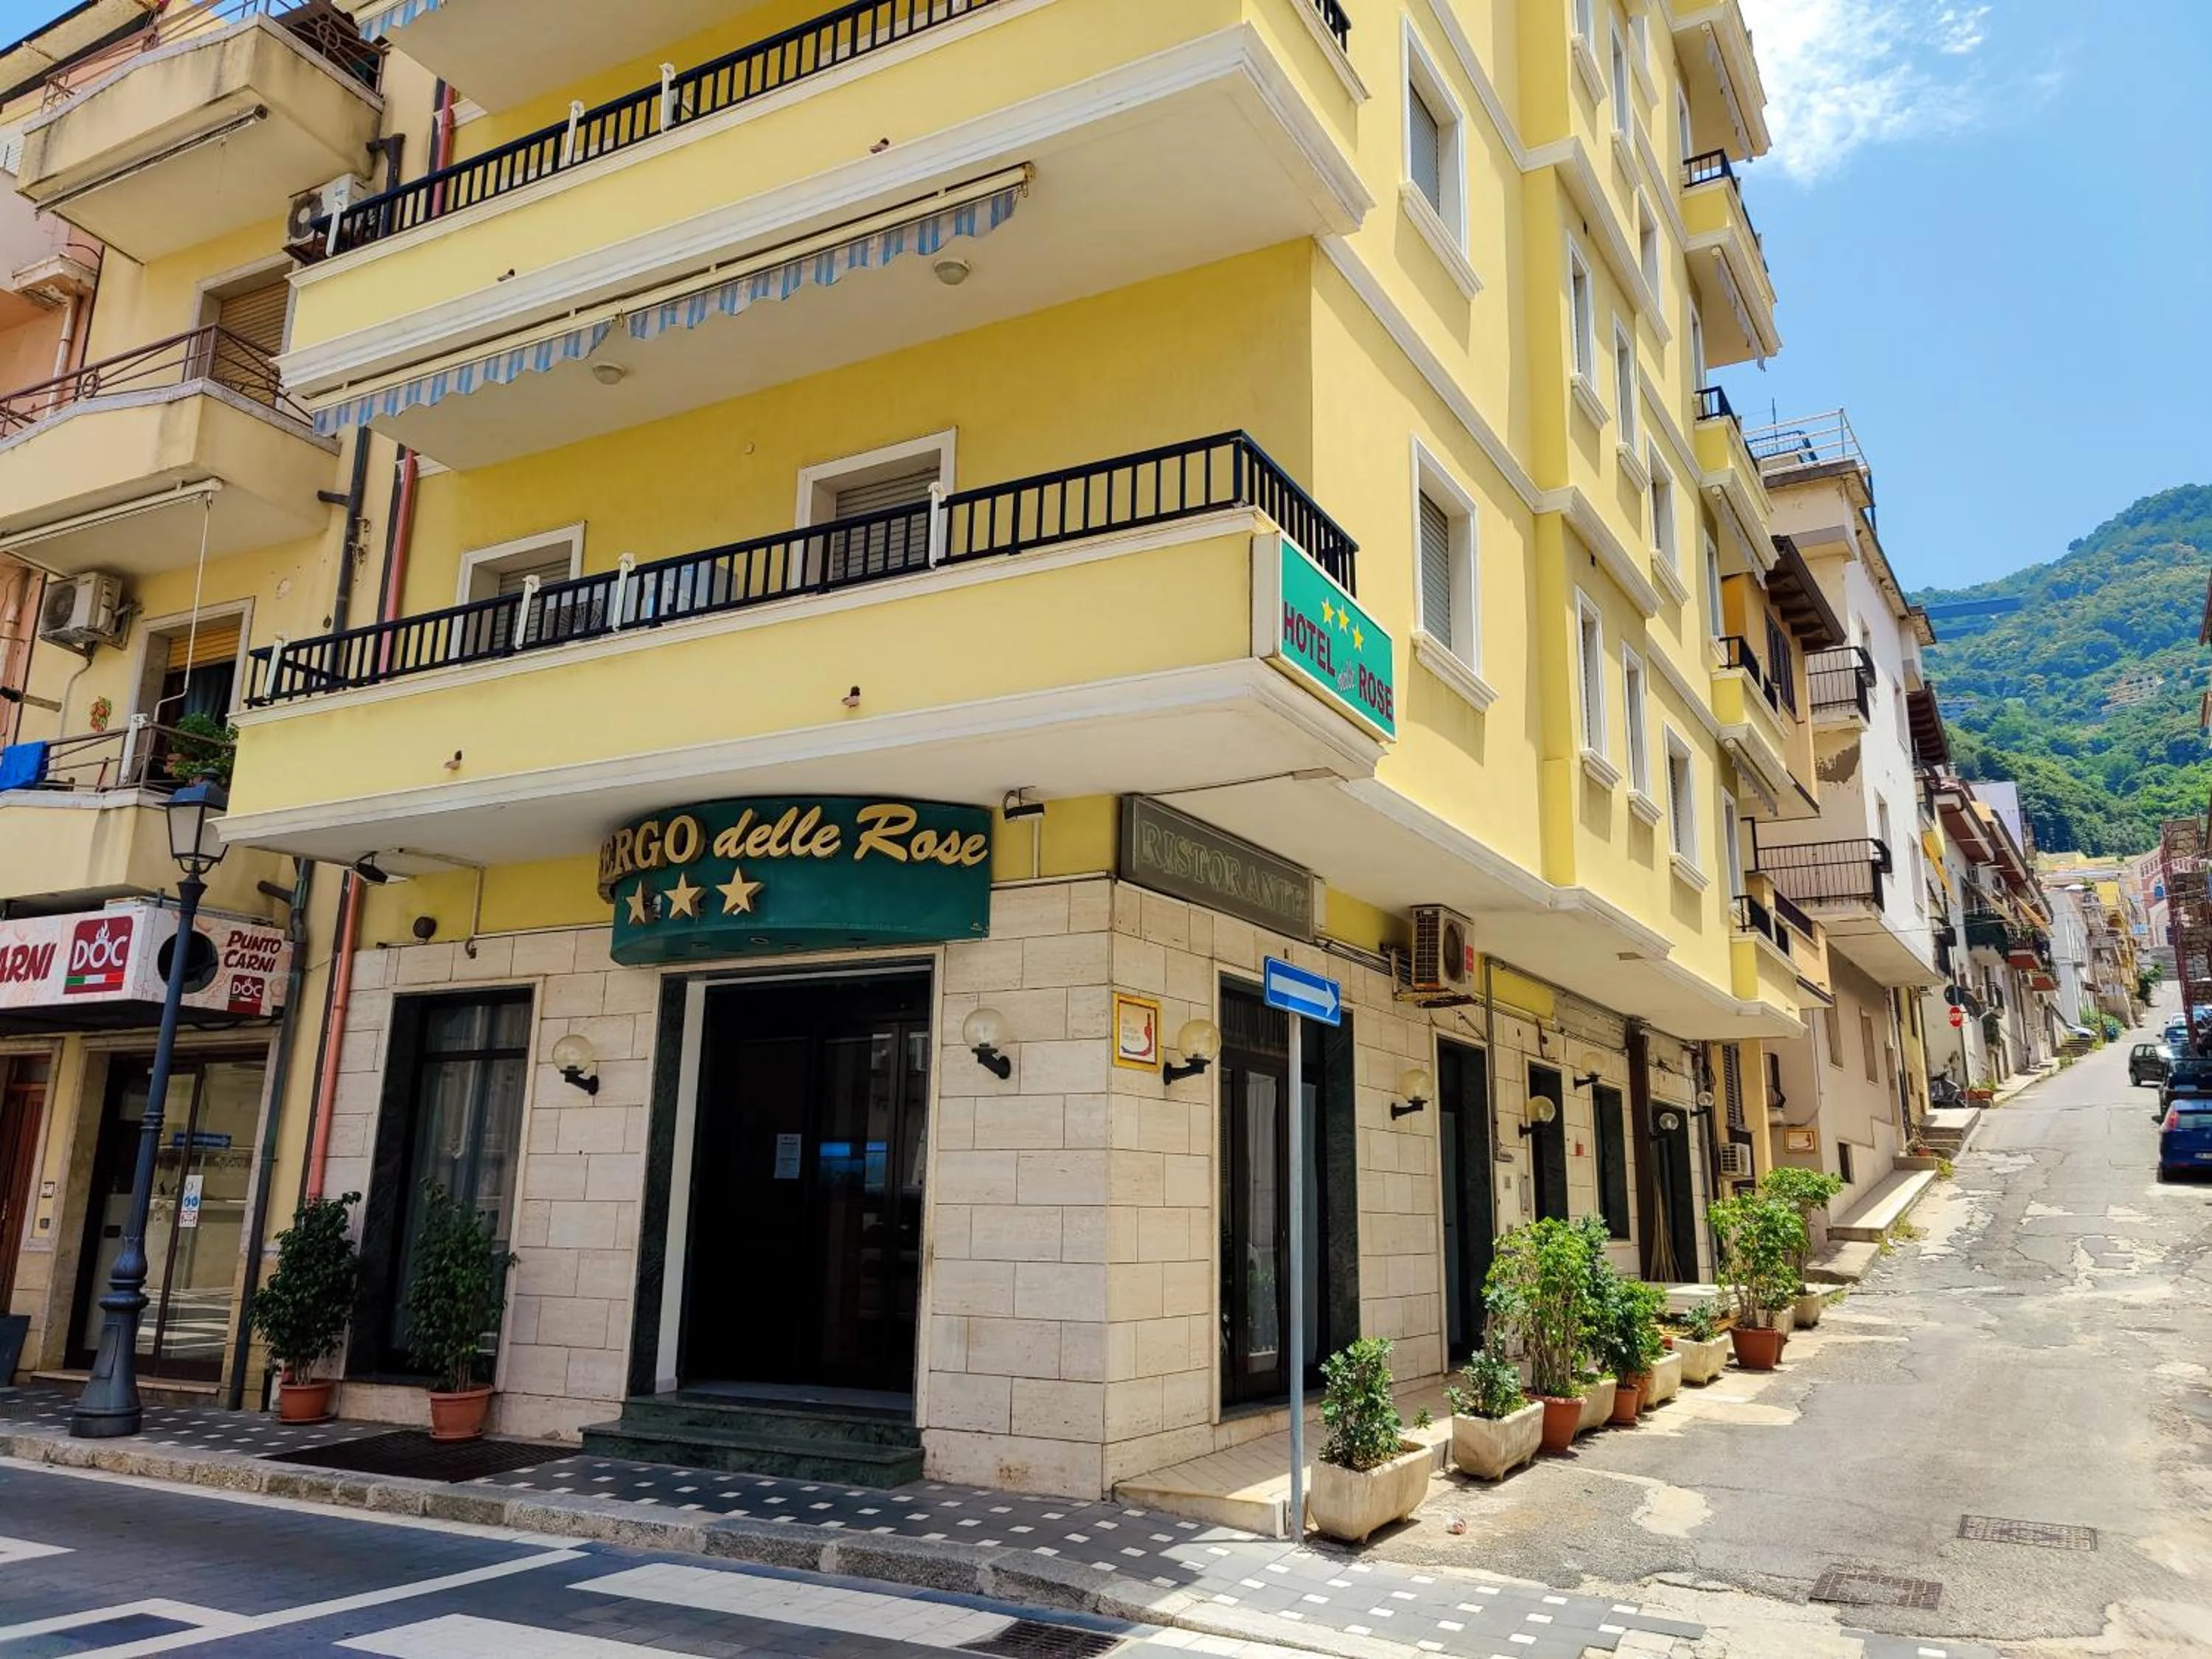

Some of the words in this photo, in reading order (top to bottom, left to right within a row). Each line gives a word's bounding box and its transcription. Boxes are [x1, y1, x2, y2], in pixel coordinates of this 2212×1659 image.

[1283, 600, 1335, 677] HOTEL
[1358, 663, 1394, 722] ROSE
[599, 814, 699, 884] ERGO
[713, 805, 842, 859] delle
[853, 803, 990, 867] Rose
[1139, 820, 1304, 922] RISTORANTE
[72, 933, 129, 972] DOC
[223, 950, 276, 973] CARNI
[226, 930, 282, 954] PUNTO
[232, 981, 263, 997] DOC
